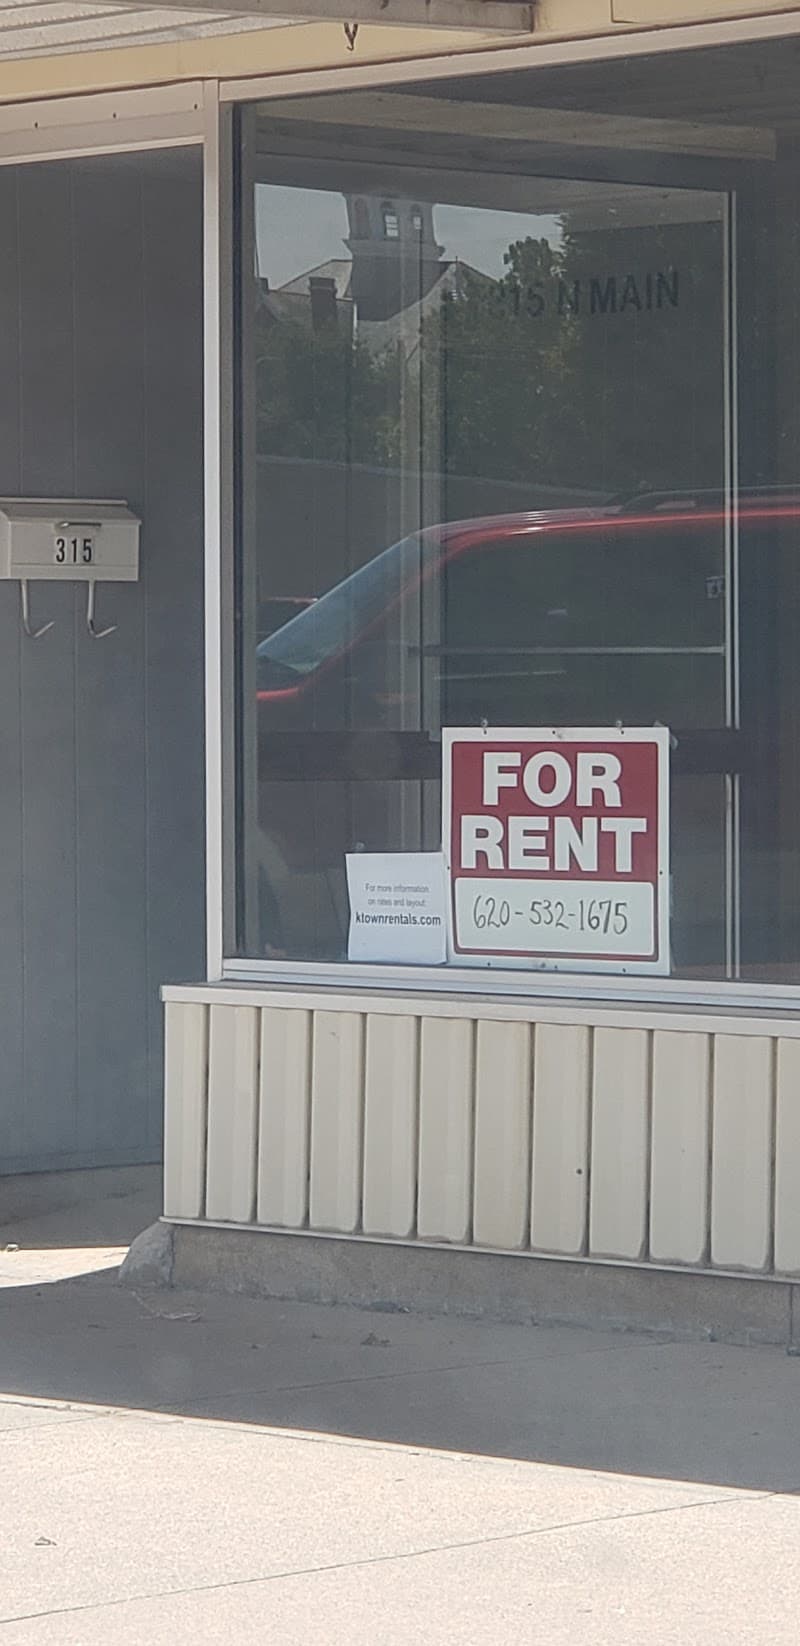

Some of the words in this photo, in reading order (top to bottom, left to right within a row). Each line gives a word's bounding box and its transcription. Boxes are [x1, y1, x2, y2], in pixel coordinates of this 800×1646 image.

[557, 279, 579, 315] N
[589, 270, 680, 314] MAIN
[56, 538, 92, 563] 315
[482, 750, 622, 807] FOR
[460, 814, 648, 873] RENT
[365, 883, 376, 892] For
[393, 883, 429, 893] information
[393, 897, 405, 906] and
[355, 912, 441, 926] ktownrentals.com
[473, 895, 628, 934] 620-532-1675
